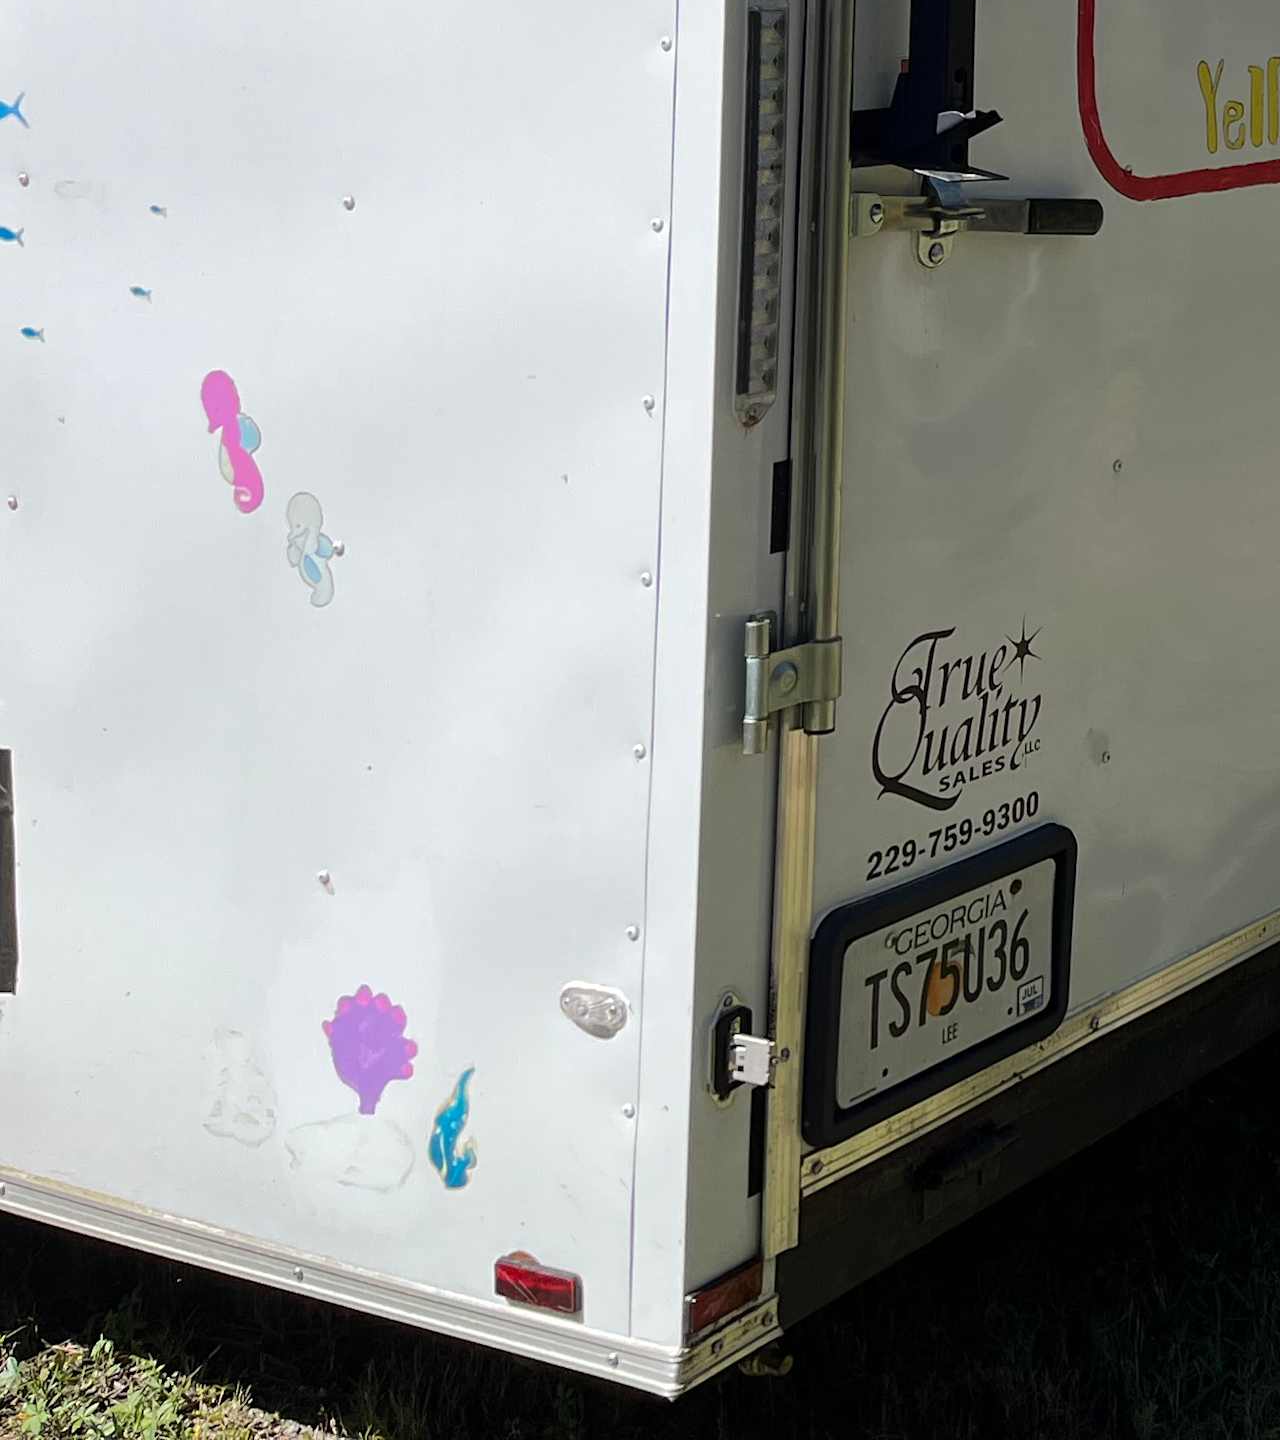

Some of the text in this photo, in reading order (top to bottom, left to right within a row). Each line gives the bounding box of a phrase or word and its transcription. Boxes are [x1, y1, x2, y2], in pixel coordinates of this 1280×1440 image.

[891, 626, 1007, 714] True
[872, 685, 1042, 811] Quality
[938, 756, 1005, 793] SALES
[865, 791, 1040, 881] 229-759-9300
[894, 889, 1007, 956] GEORGIA
[864, 908, 1029, 1050] TS75U36
[941, 1022, 959, 1045] LEE
